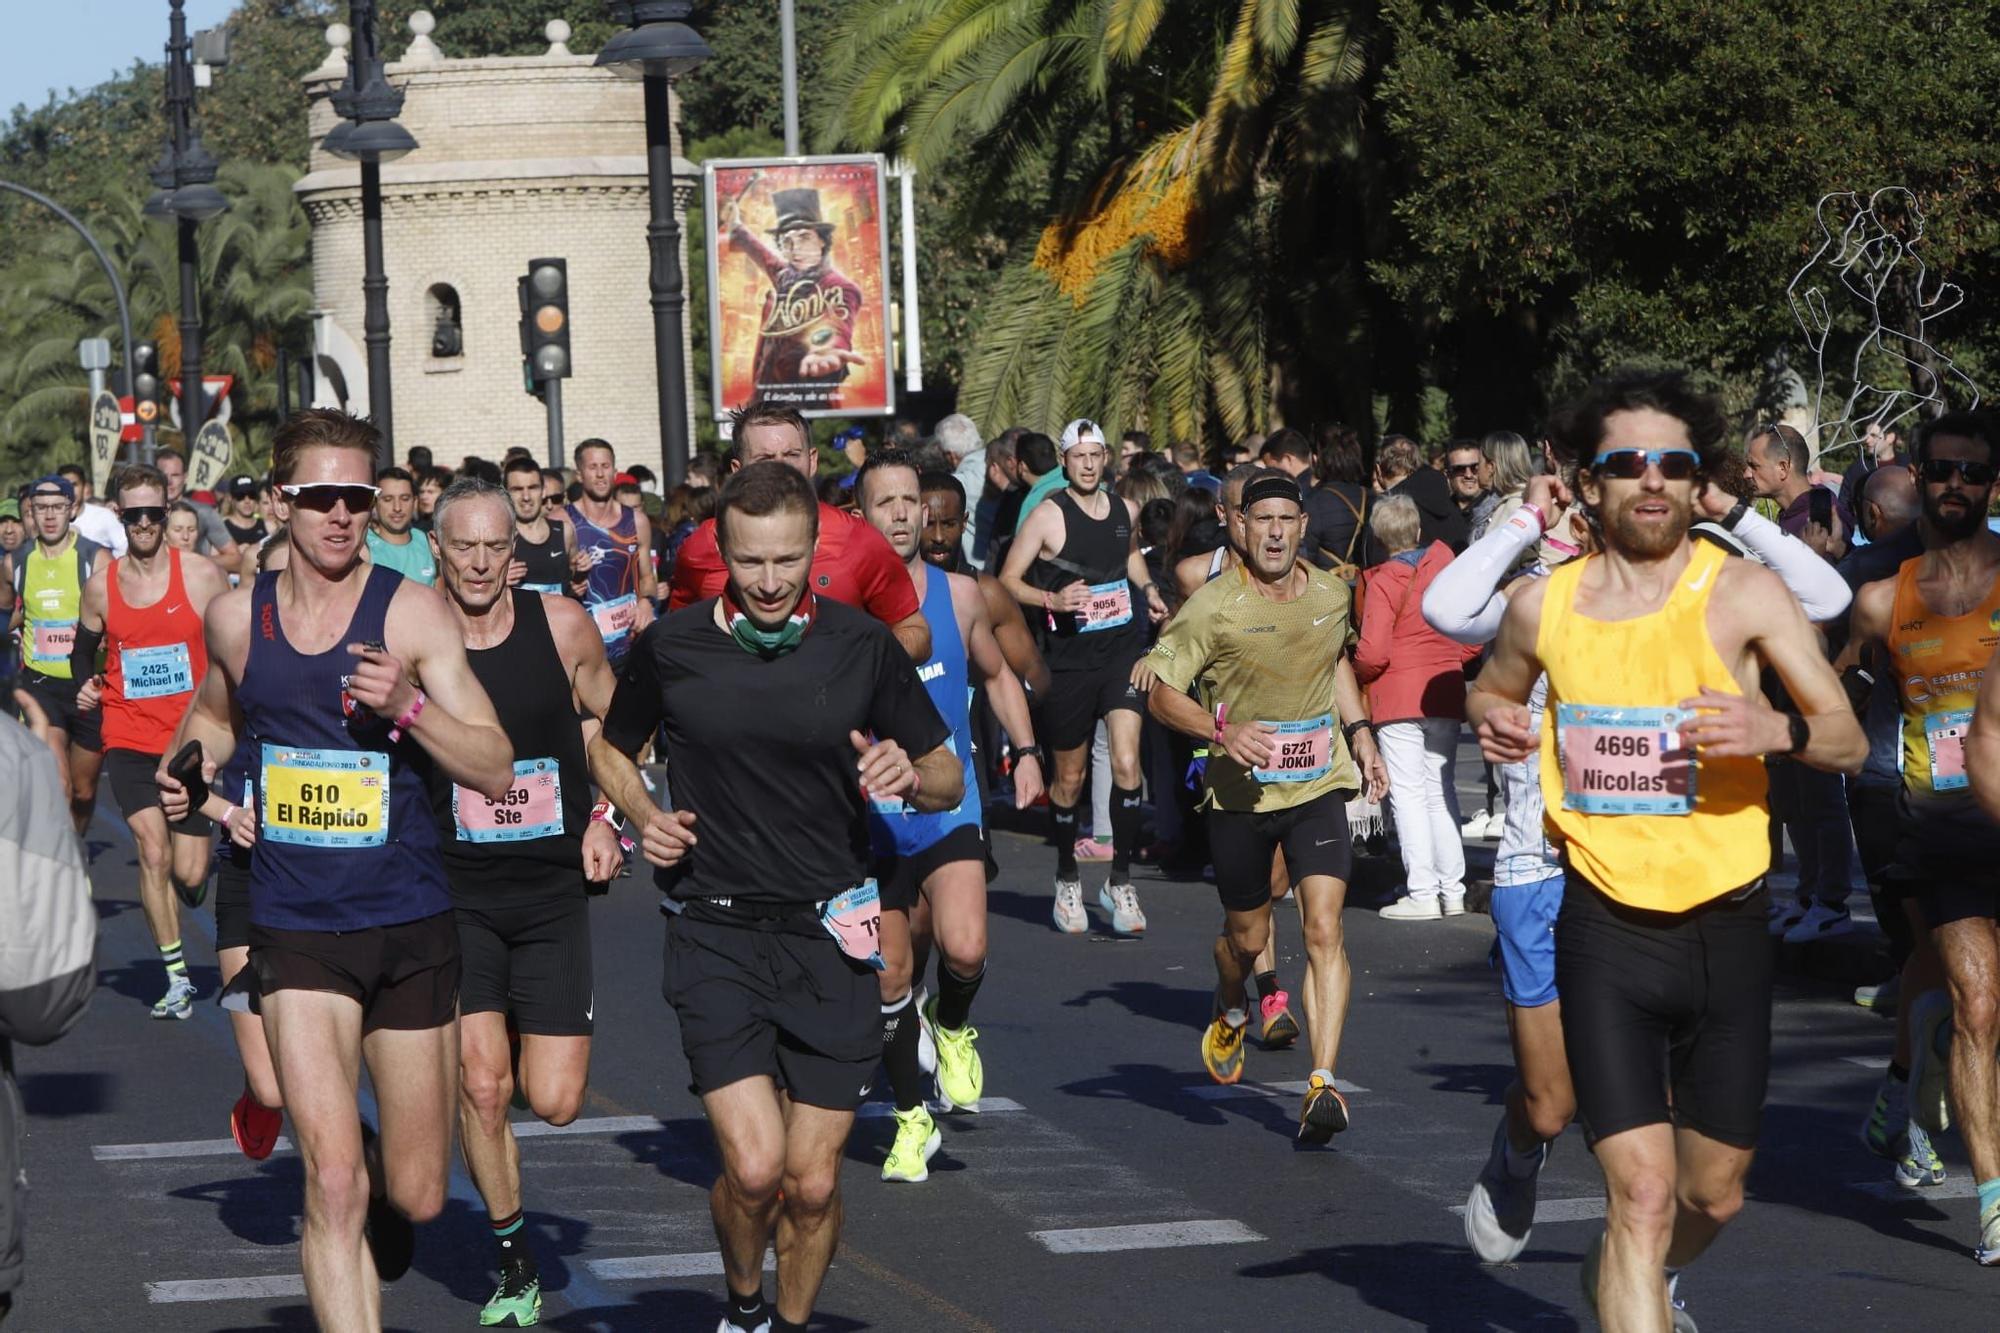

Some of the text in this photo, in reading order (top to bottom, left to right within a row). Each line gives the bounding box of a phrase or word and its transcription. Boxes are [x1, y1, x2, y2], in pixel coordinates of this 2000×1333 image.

[755, 280, 849, 336] Wonka
[1093, 599, 1116, 610] 9056
[141, 664, 169, 676] 2425
[131, 672, 185, 688] Michael M
[1282, 740, 1313, 756] 6727
[1594, 735, 1650, 757] 4696
[1278, 754, 1315, 769] JOKIN
[1582, 768, 1664, 792] Nicolas
[300, 783, 340, 804] 610
[278, 803, 368, 831] El Rápido
[494, 809, 522, 825] Ste
[860, 915, 880, 937] 78
